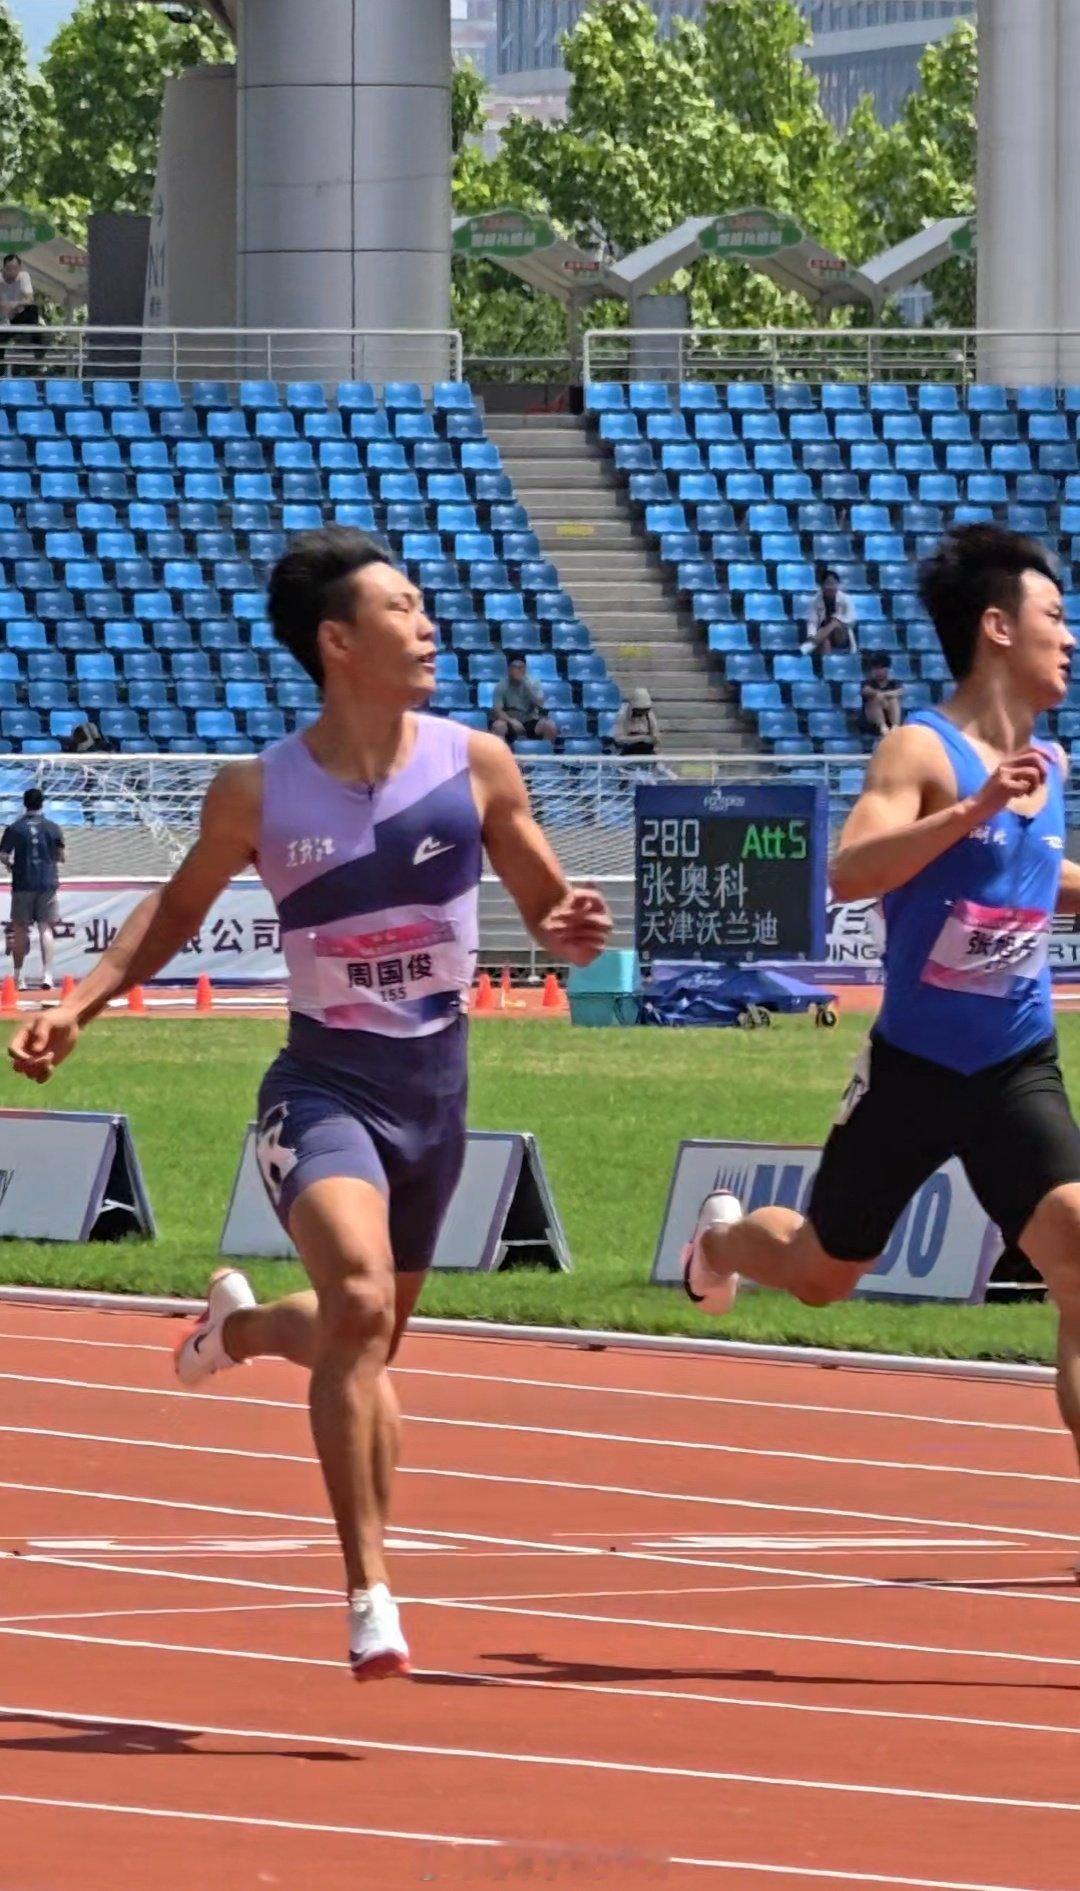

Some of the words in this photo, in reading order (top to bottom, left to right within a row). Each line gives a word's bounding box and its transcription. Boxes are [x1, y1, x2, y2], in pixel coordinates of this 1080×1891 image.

[641, 818, 700, 858] 280
[641, 861, 748, 909] 张奥科
[640, 910, 780, 946] 天津沃兰迪
[347, 953, 433, 988] 周国俊
[380, 987, 407, 1003] 155
